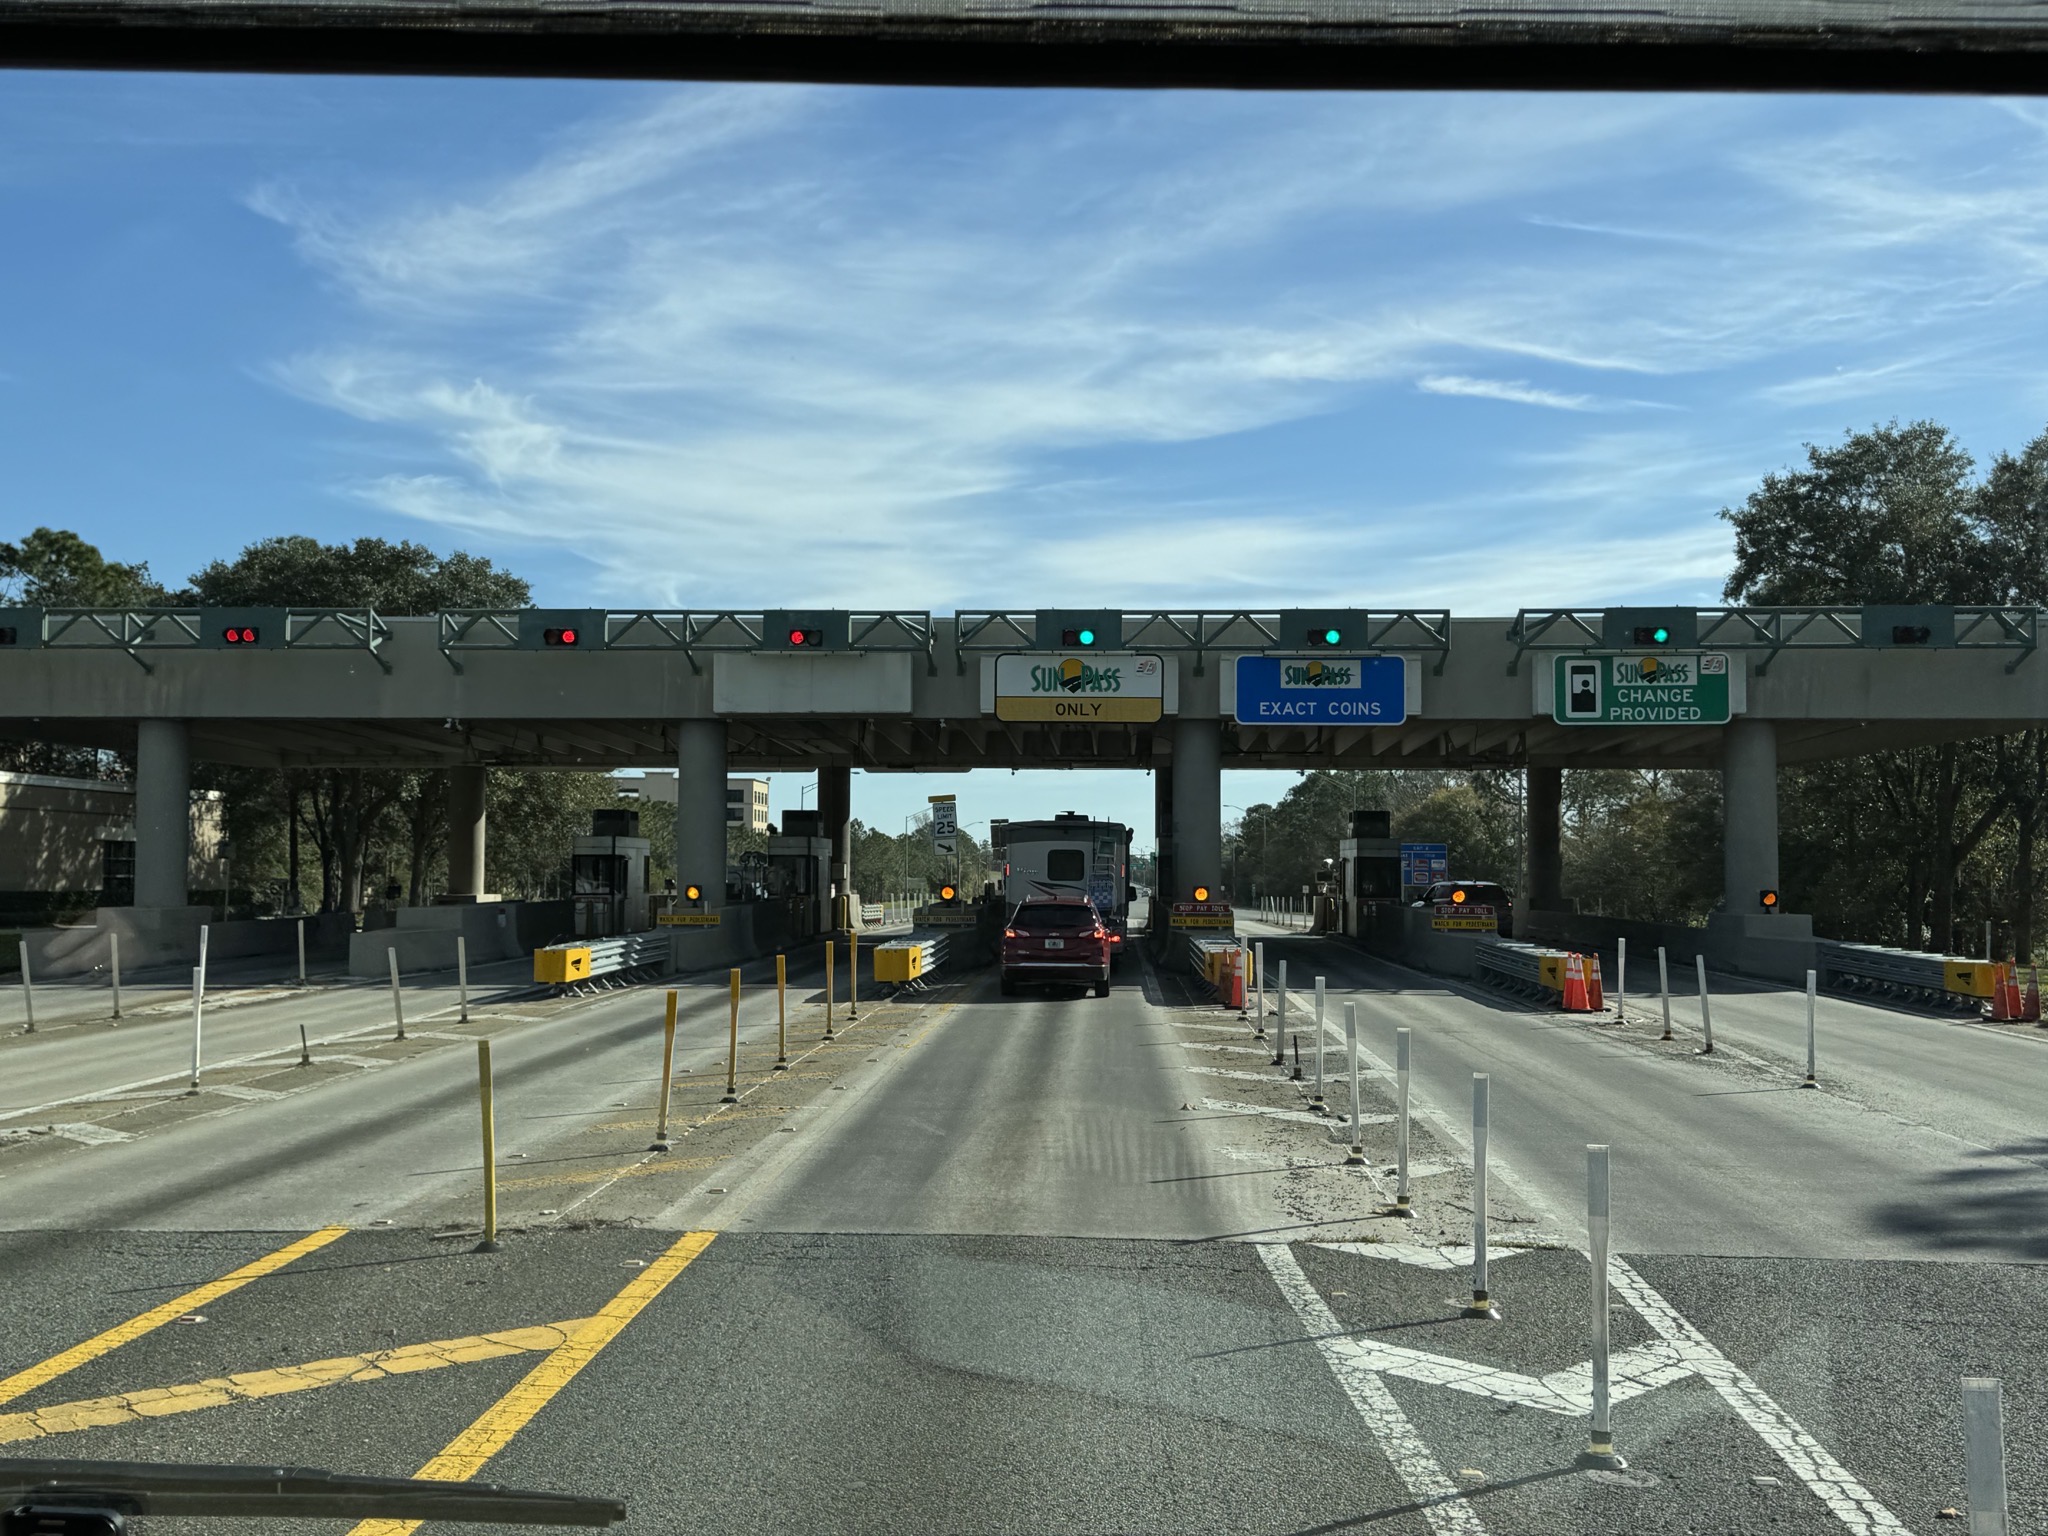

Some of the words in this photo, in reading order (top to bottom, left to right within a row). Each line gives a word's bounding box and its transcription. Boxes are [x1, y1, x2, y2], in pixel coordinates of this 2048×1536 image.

[1617, 688, 1694, 703] CHANGE
[1055, 703, 1102, 716] ONLY
[1259, 702, 1317, 715] EXACT
[1328, 702, 1381, 715] COINS
[1609, 707, 1701, 721] PROVIDED
[936, 821, 956, 834] 25
[1474, 907, 1488, 915] TOLL
[1465, 920, 1496, 928] PEDESTRIANS
